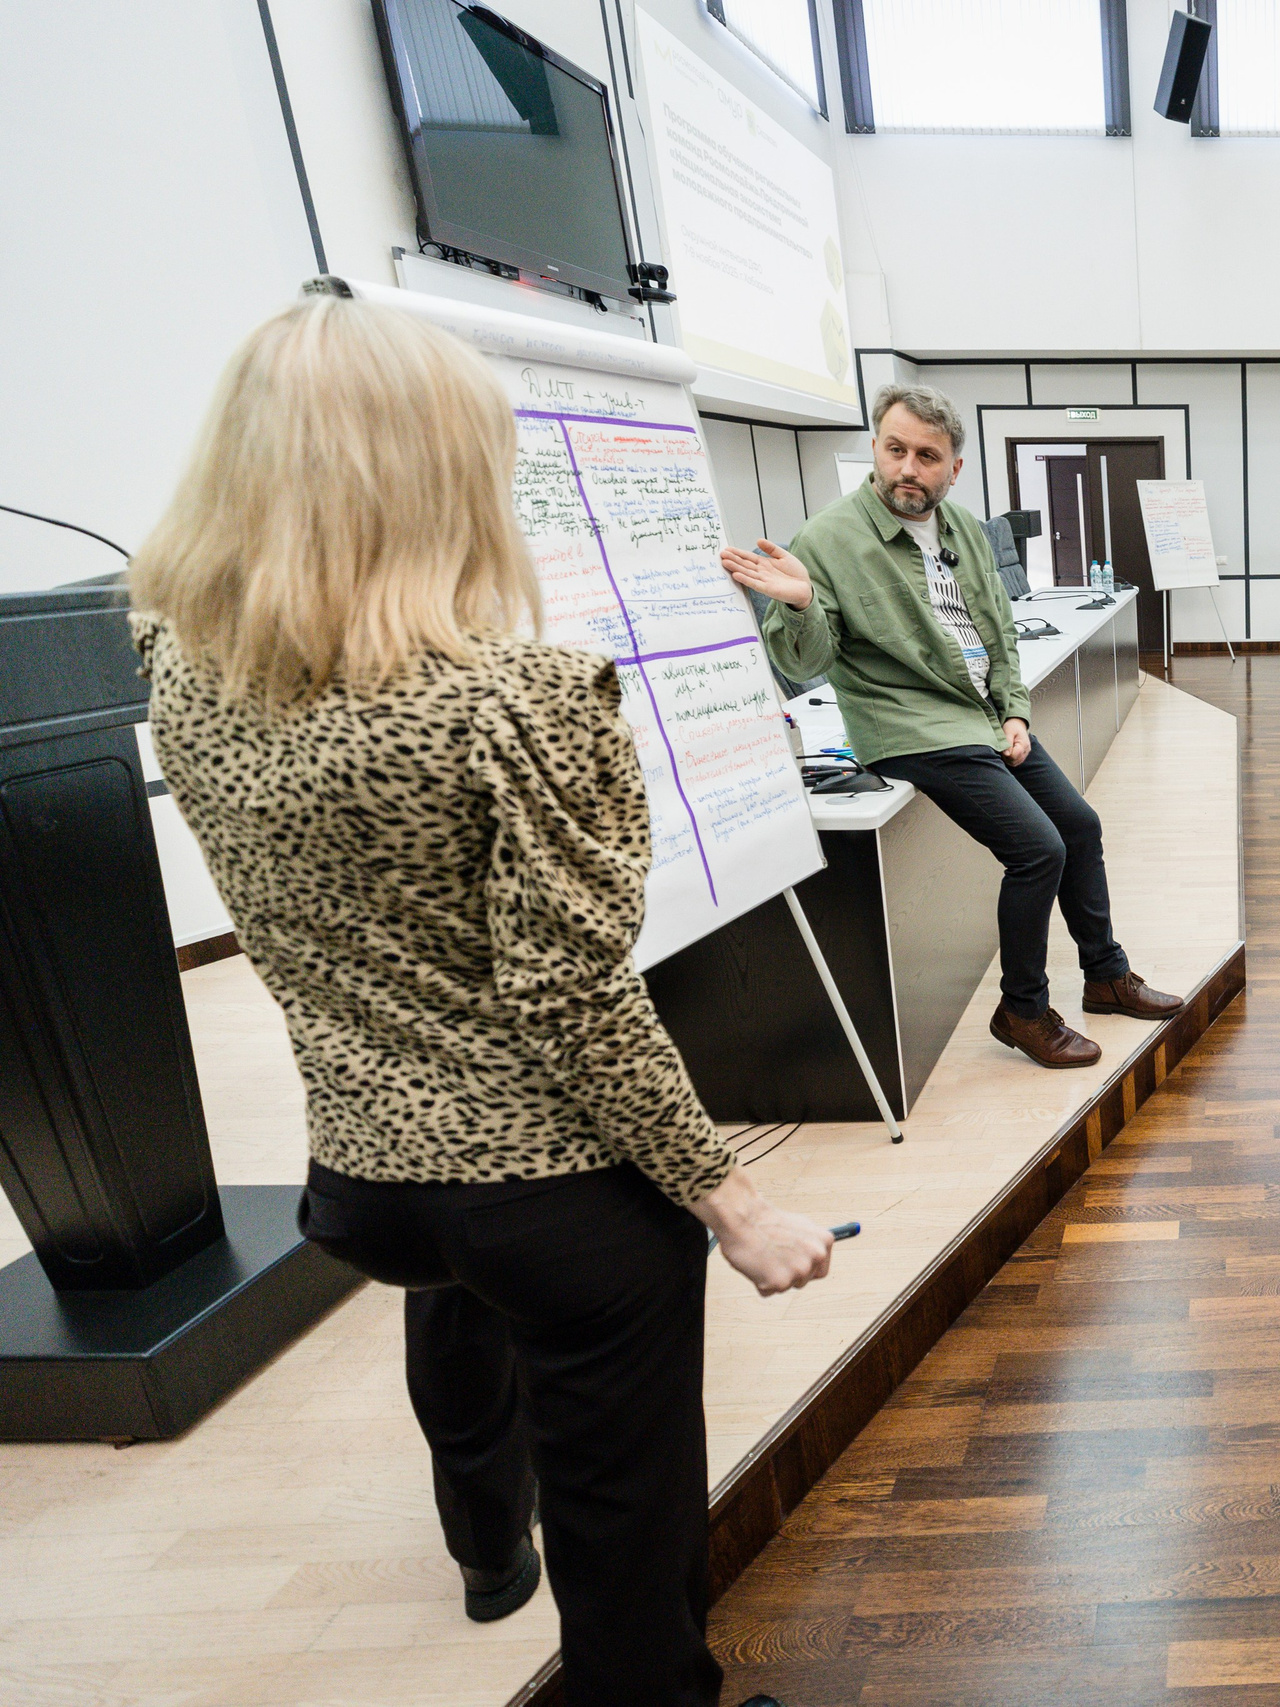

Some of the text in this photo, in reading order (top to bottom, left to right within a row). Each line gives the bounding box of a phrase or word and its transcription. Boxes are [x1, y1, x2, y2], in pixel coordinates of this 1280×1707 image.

[663, 102, 717, 151] Программа
[717, 144, 754, 177] обучения
[665, 126, 703, 162] команд
[669, 148, 740, 199] «Национальная
[1070, 411, 1096, 419] ВЫХОД
